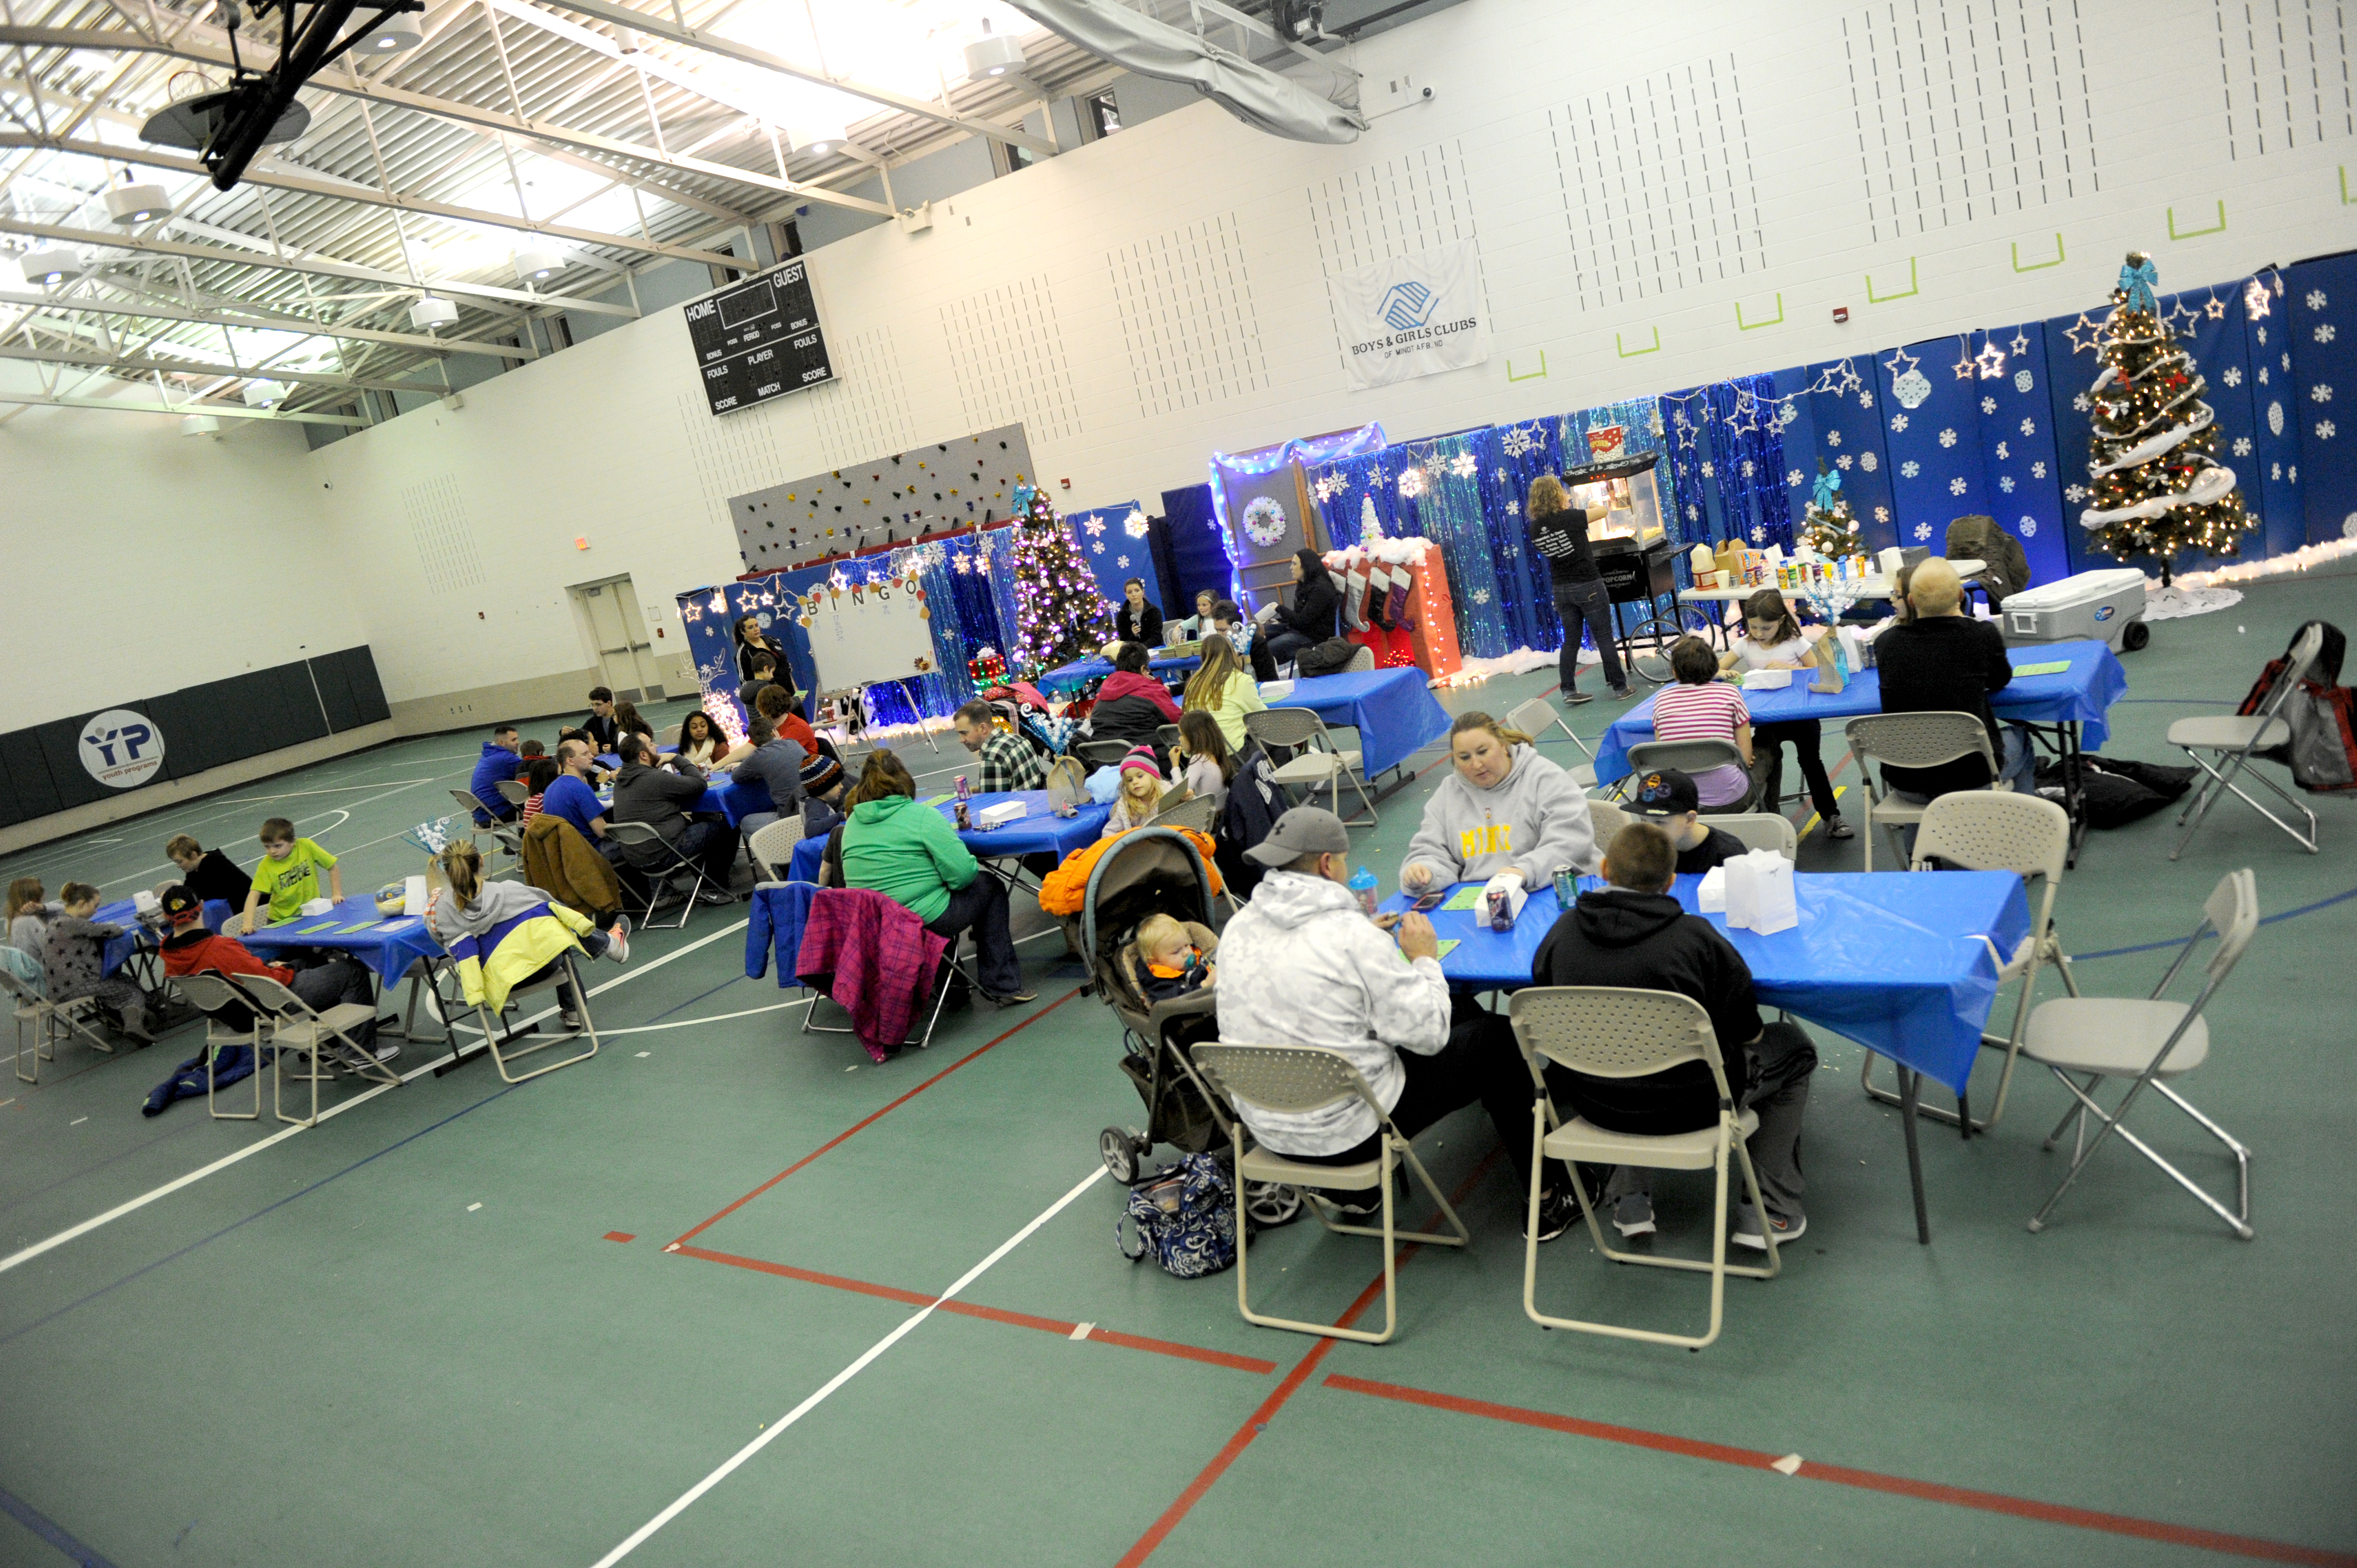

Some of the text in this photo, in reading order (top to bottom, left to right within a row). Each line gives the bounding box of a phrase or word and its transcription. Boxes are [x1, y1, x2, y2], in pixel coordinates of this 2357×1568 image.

[773, 264, 803, 288] GUEST
[686, 300, 716, 322] HOME
[790, 318, 807, 330] BONUS
[743, 331, 760, 342] PERIOD
[794, 334, 817, 349] FOULS
[1351, 317, 1477, 355] BOYS & GIRLS CLUBS
[706, 349, 722, 360] BONUS
[1396, 345, 1414, 355] MINOT
[1434, 339, 1443, 348] ND
[748, 349, 774, 365] PLAYER
[707, 365, 728, 379] FOULS
[802, 367, 827, 382] SCORE
[758, 382, 781, 396] MATCH
[715, 396, 738, 410] SCORE
[84, 724, 151, 767] YP
[102, 760, 158, 781] youth programs
